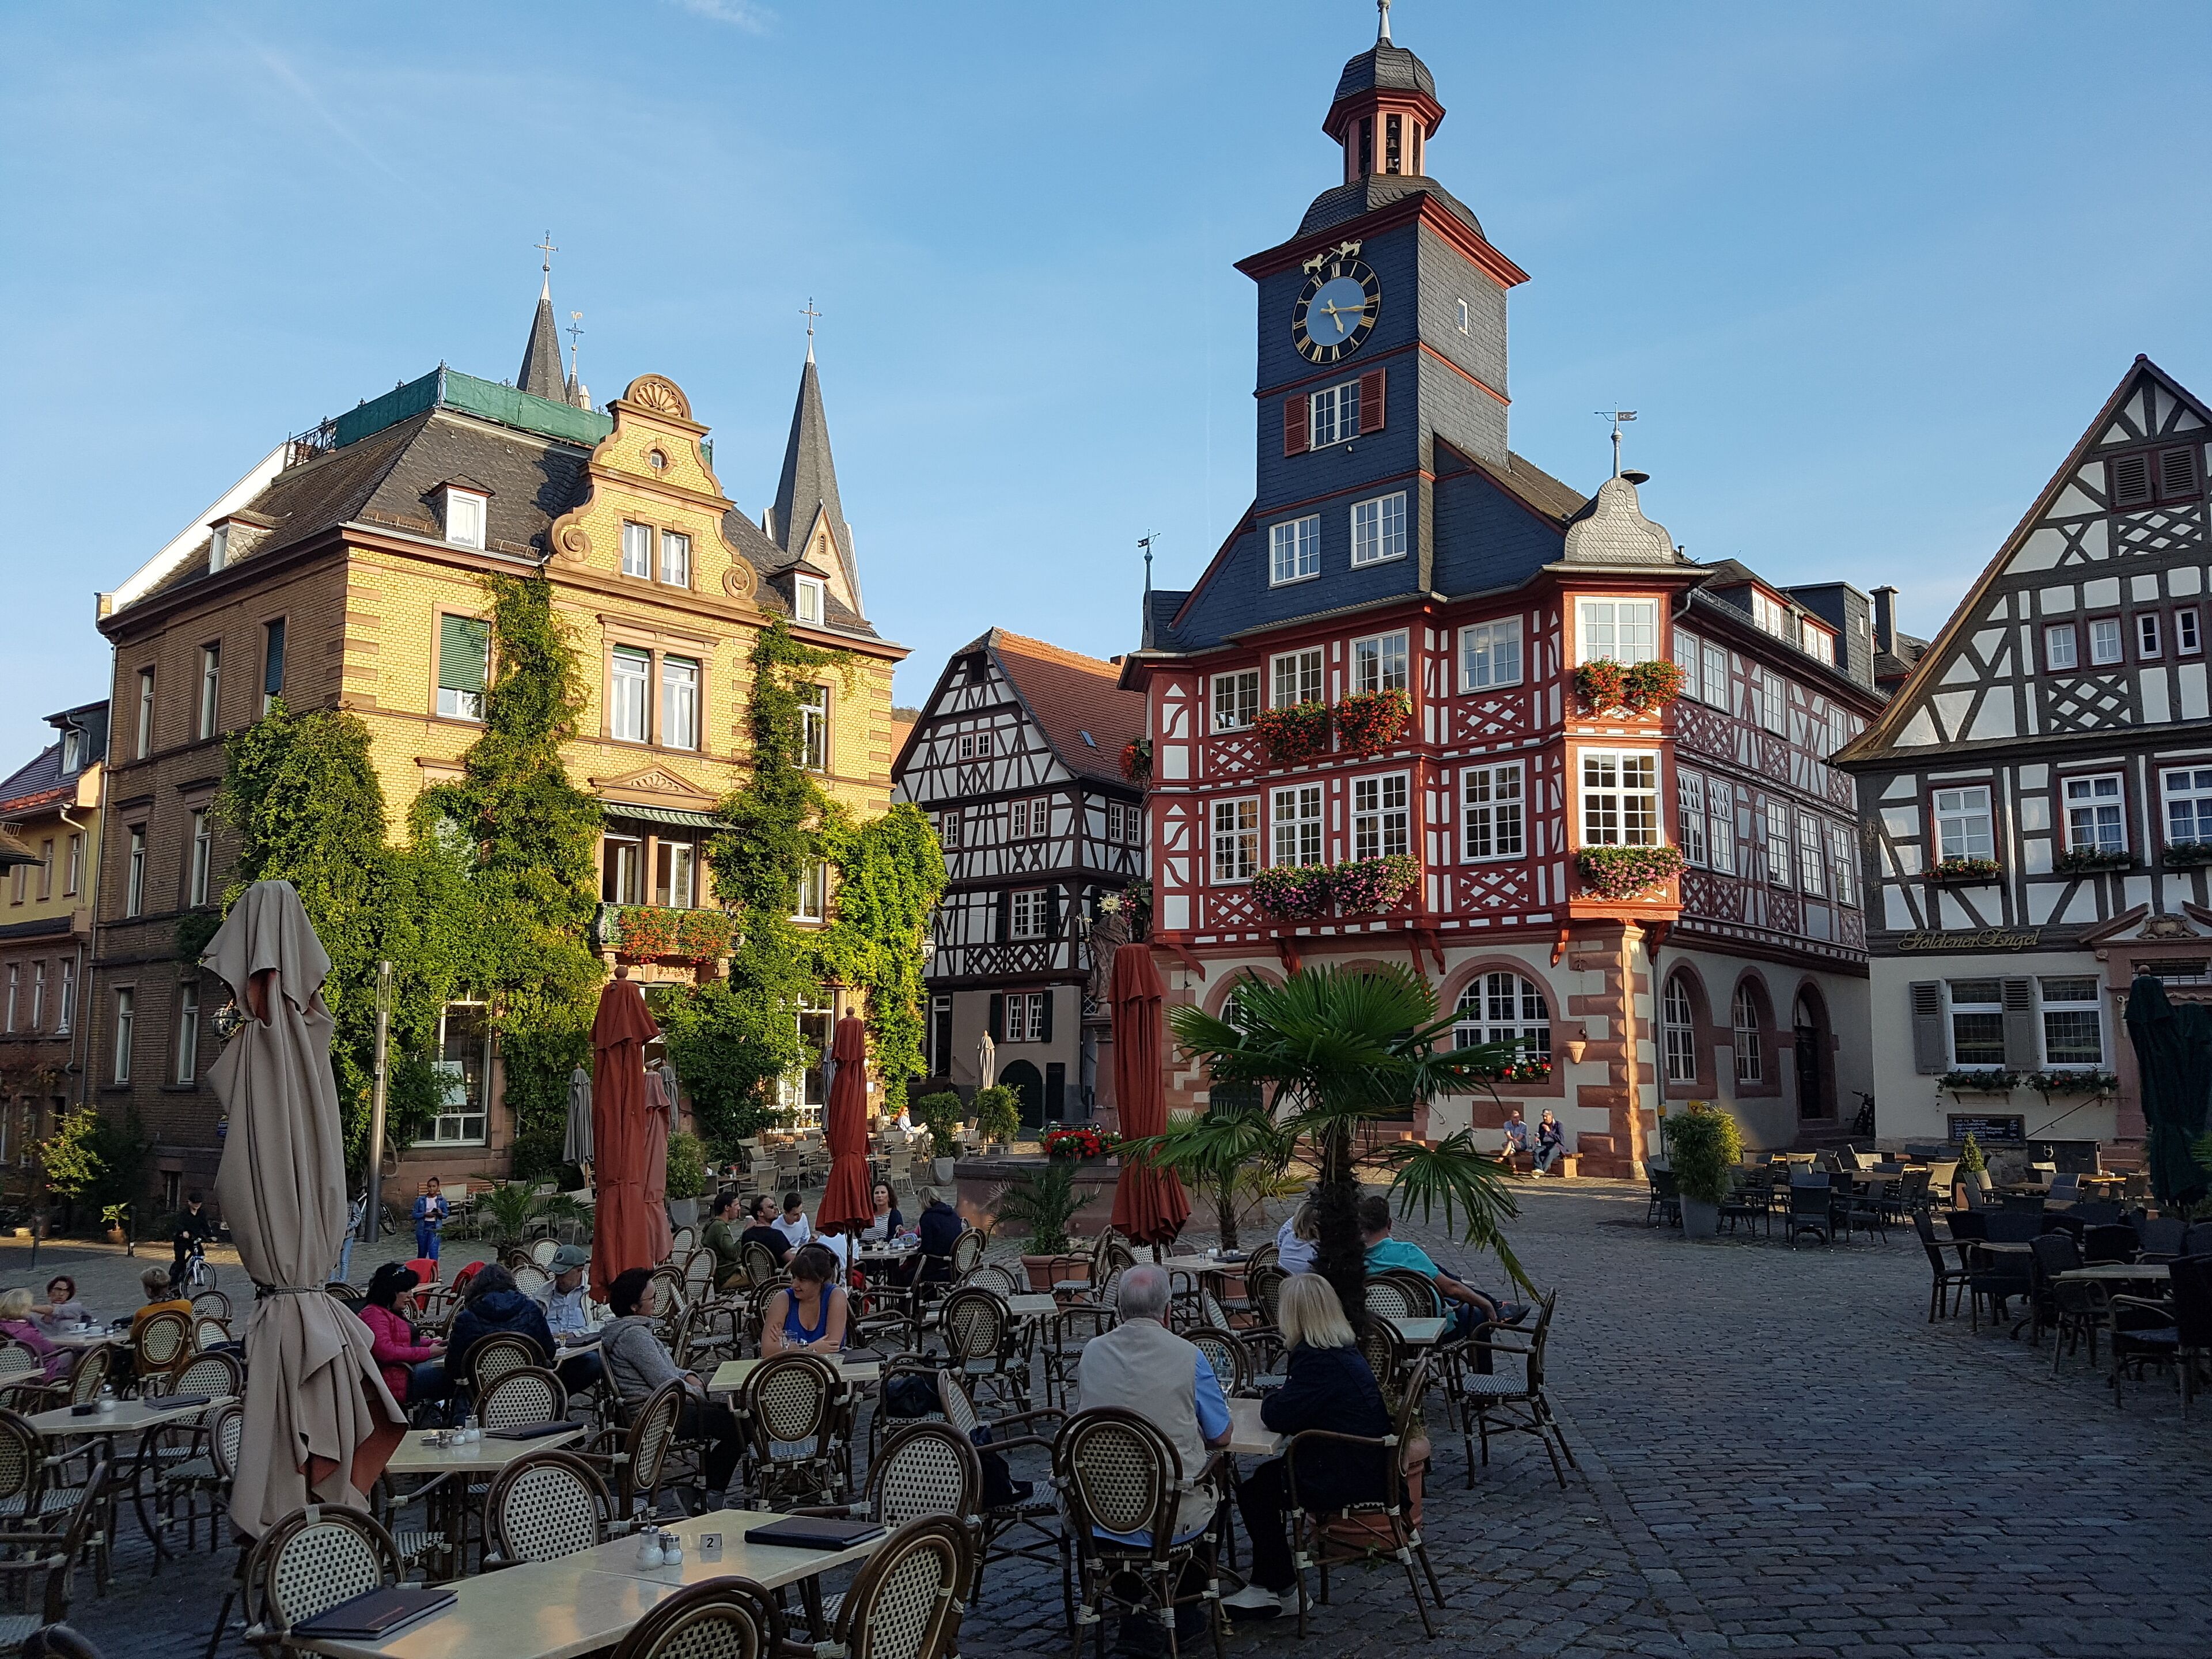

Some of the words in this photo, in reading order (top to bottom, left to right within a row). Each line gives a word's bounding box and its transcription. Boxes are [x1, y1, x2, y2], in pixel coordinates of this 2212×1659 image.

[1331, 262, 1340, 279] XII
[1349, 262, 1358, 277] I
[1312, 275, 1323, 290] XI
[1361, 272, 1374, 287] II
[1297, 297, 1312, 307] X
[1365, 294, 1379, 305] III
[1293, 317, 1306, 330] IX
[1359, 316, 1375, 328] IIII
[1297, 335, 1311, 354] VIII
[1350, 336, 1359, 349] V
[1311, 345, 1323, 361] VII
[1332, 345, 1340, 360] VI
[1897, 931, 1979, 950] Goldener
[1976, 928, 2040, 950] Engel
[707, 1537, 714, 1548] 2
